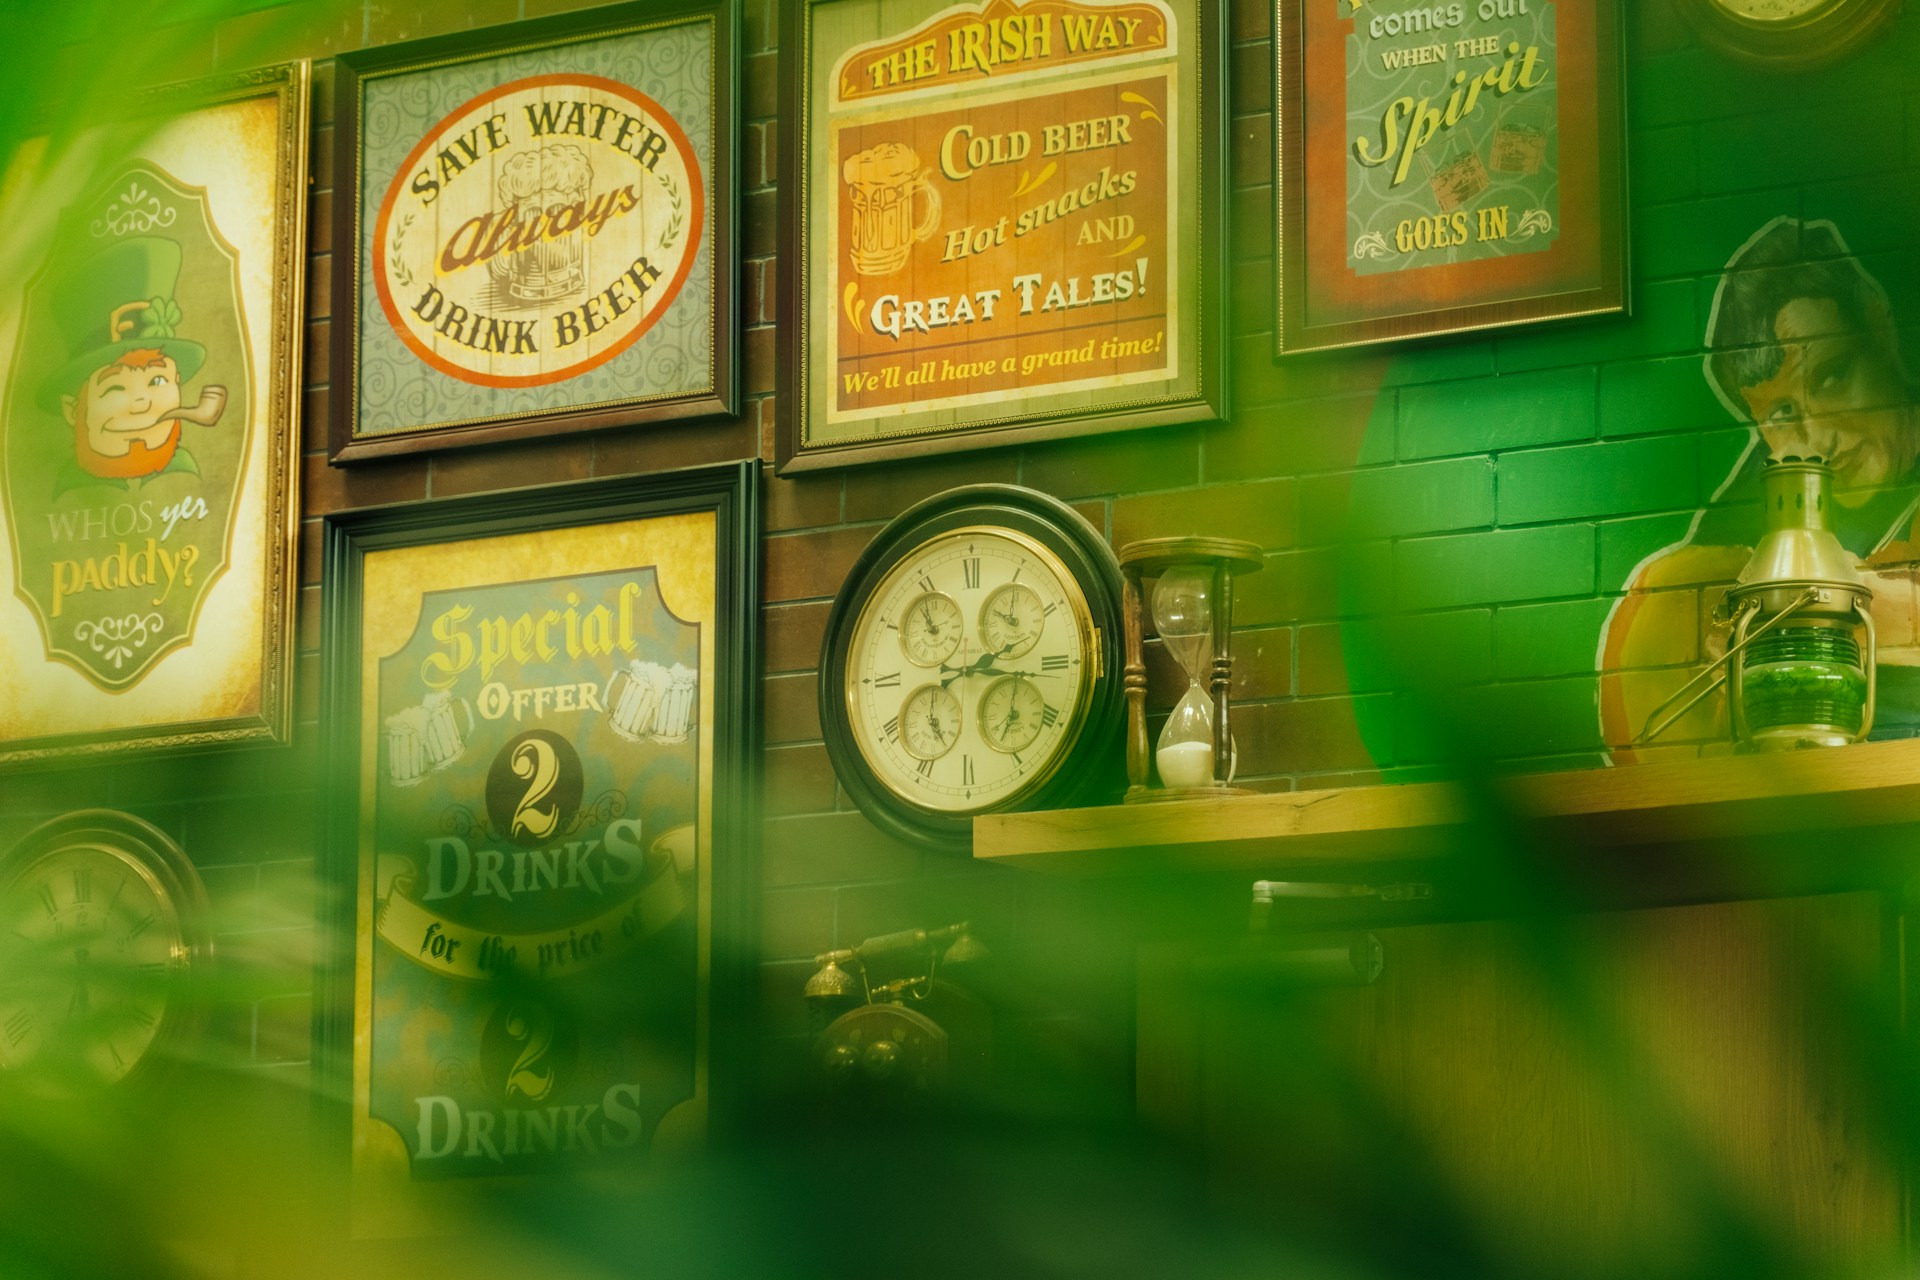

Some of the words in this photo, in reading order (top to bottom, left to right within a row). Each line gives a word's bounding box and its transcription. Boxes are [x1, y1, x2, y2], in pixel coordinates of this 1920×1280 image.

[866, 50, 941, 90] THE
[947, 13, 1052, 75] IRISH
[1063, 14, 1143, 54] WAY
[1369, 3, 1465, 39] comes
[1381, 43, 1448, 71] WHEN
[1454, 35, 1500, 60] THE
[411, 112, 509, 208] SAVE
[526, 100, 670, 174] WATER
[939, 122, 1033, 182] COLD
[1041, 113, 1133, 159] BEER
[1352, 41, 1550, 188] Spirit
[439, 183, 642, 276] Always
[940, 213, 1010, 264] Hot
[1014, 165, 1138, 239] snacks
[1076, 214, 1136, 248] AND
[1395, 209, 1469, 256] GOES
[1477, 206, 1509, 243] IN
[410, 282, 540, 355] DRINK
[553, 255, 663, 349] BEER
[869, 288, 1002, 341] GREAT
[1013, 256, 1151, 317] TALES!
[905, 356, 938, 386] all
[940, 354, 998, 382] have
[1001, 356, 1018, 375] a
[1021, 342, 1095, 376] grand
[1099, 332, 1163, 360] time!
[47, 500, 153, 544] WHOS
[160, 495, 209, 541] yer
[50, 538, 199, 618] paddy?
[421, 582, 642, 689] Special
[475, 681, 605, 721] OFFER
[510, 738, 560, 839] 2
[423, 818, 645, 902] DRINKS
[419, 921, 462, 966] for
[505, 1004, 556, 1101] 2
[413, 1083, 642, 1163] DRINKS
